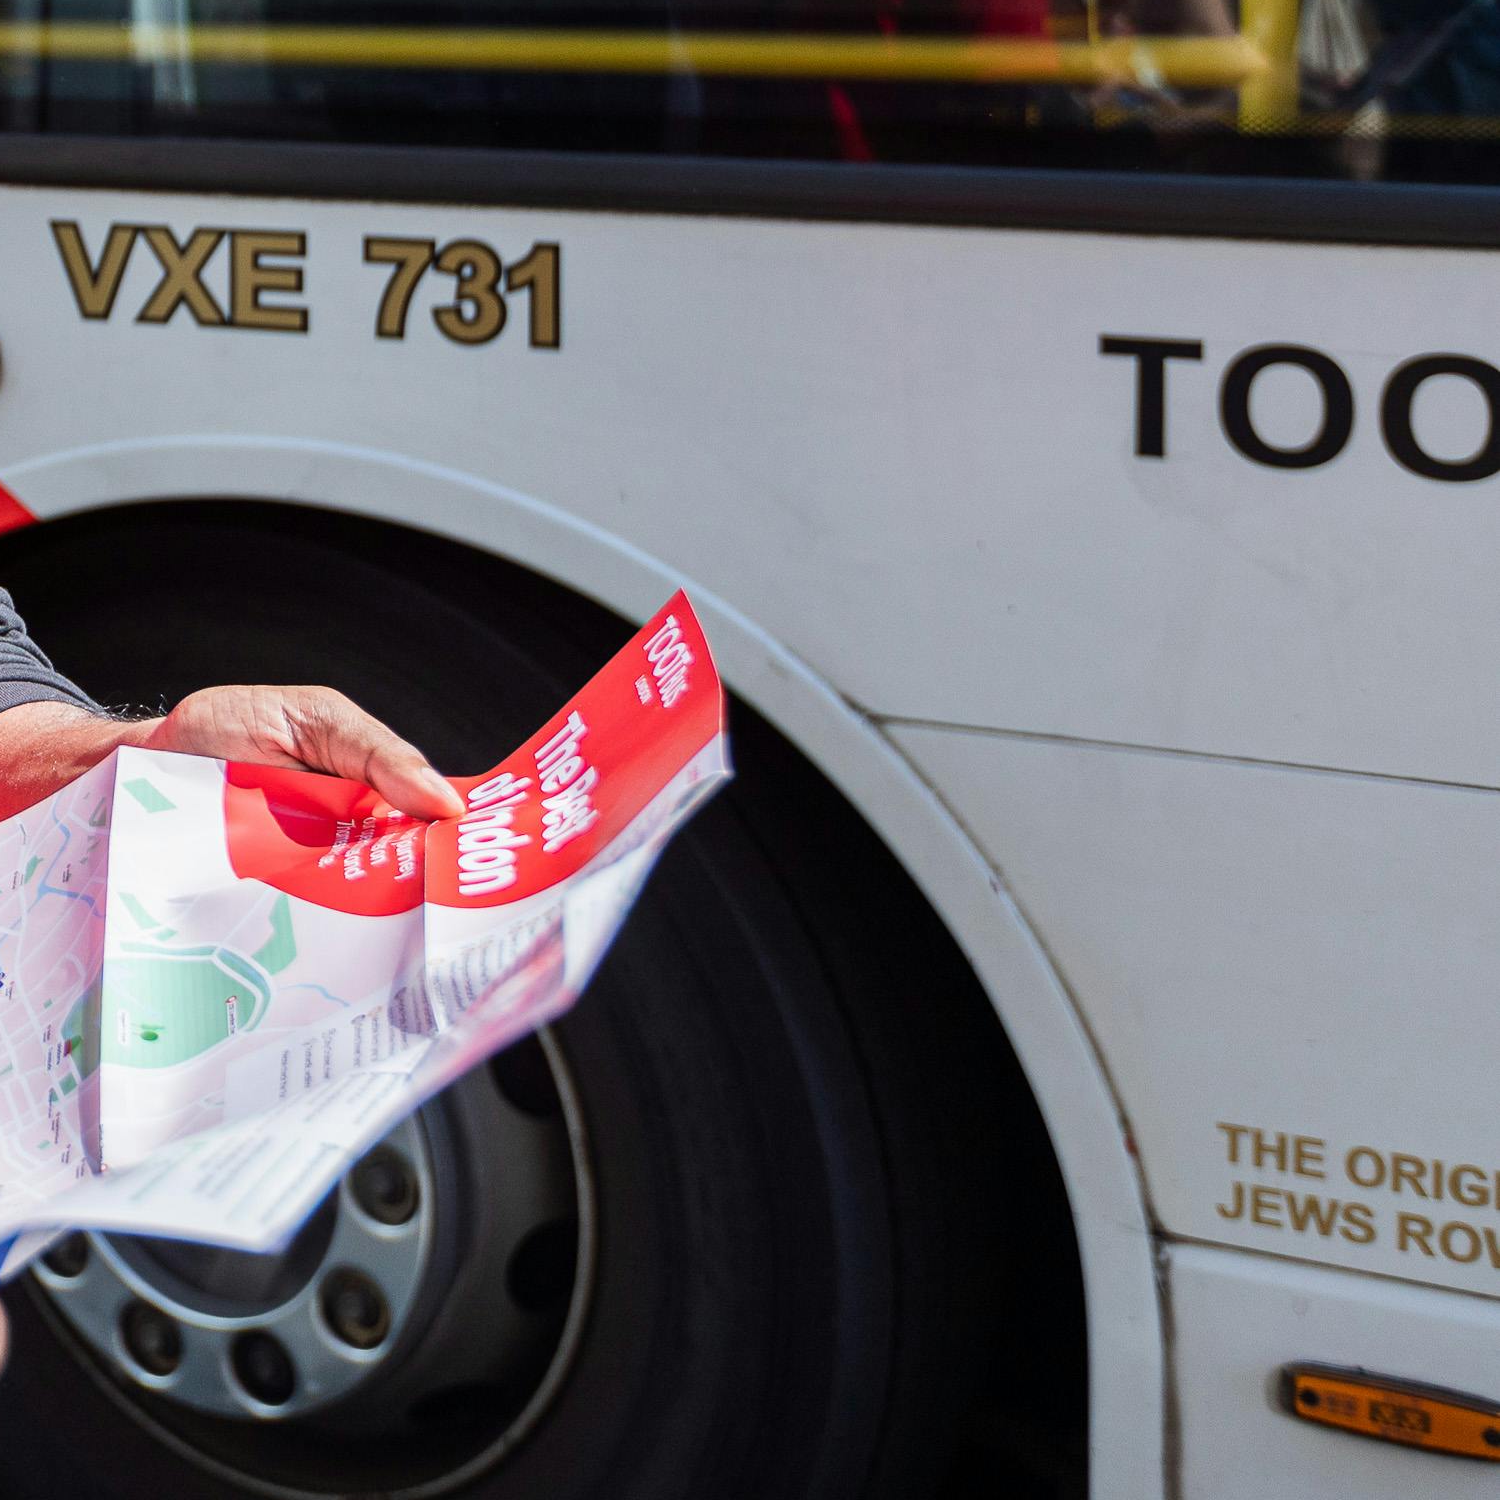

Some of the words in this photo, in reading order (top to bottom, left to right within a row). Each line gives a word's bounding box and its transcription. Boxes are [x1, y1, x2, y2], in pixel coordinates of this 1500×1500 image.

[49, 219, 309, 334] VXE
[363, 235, 561, 350] 731
[1098, 332, 1500, 483] TOO
[534, 710, 588, 794] The
[541, 766, 598, 853] Best
[1216, 1121, 1326, 1180] THE
[1216, 1180, 1376, 1244] JEWS
